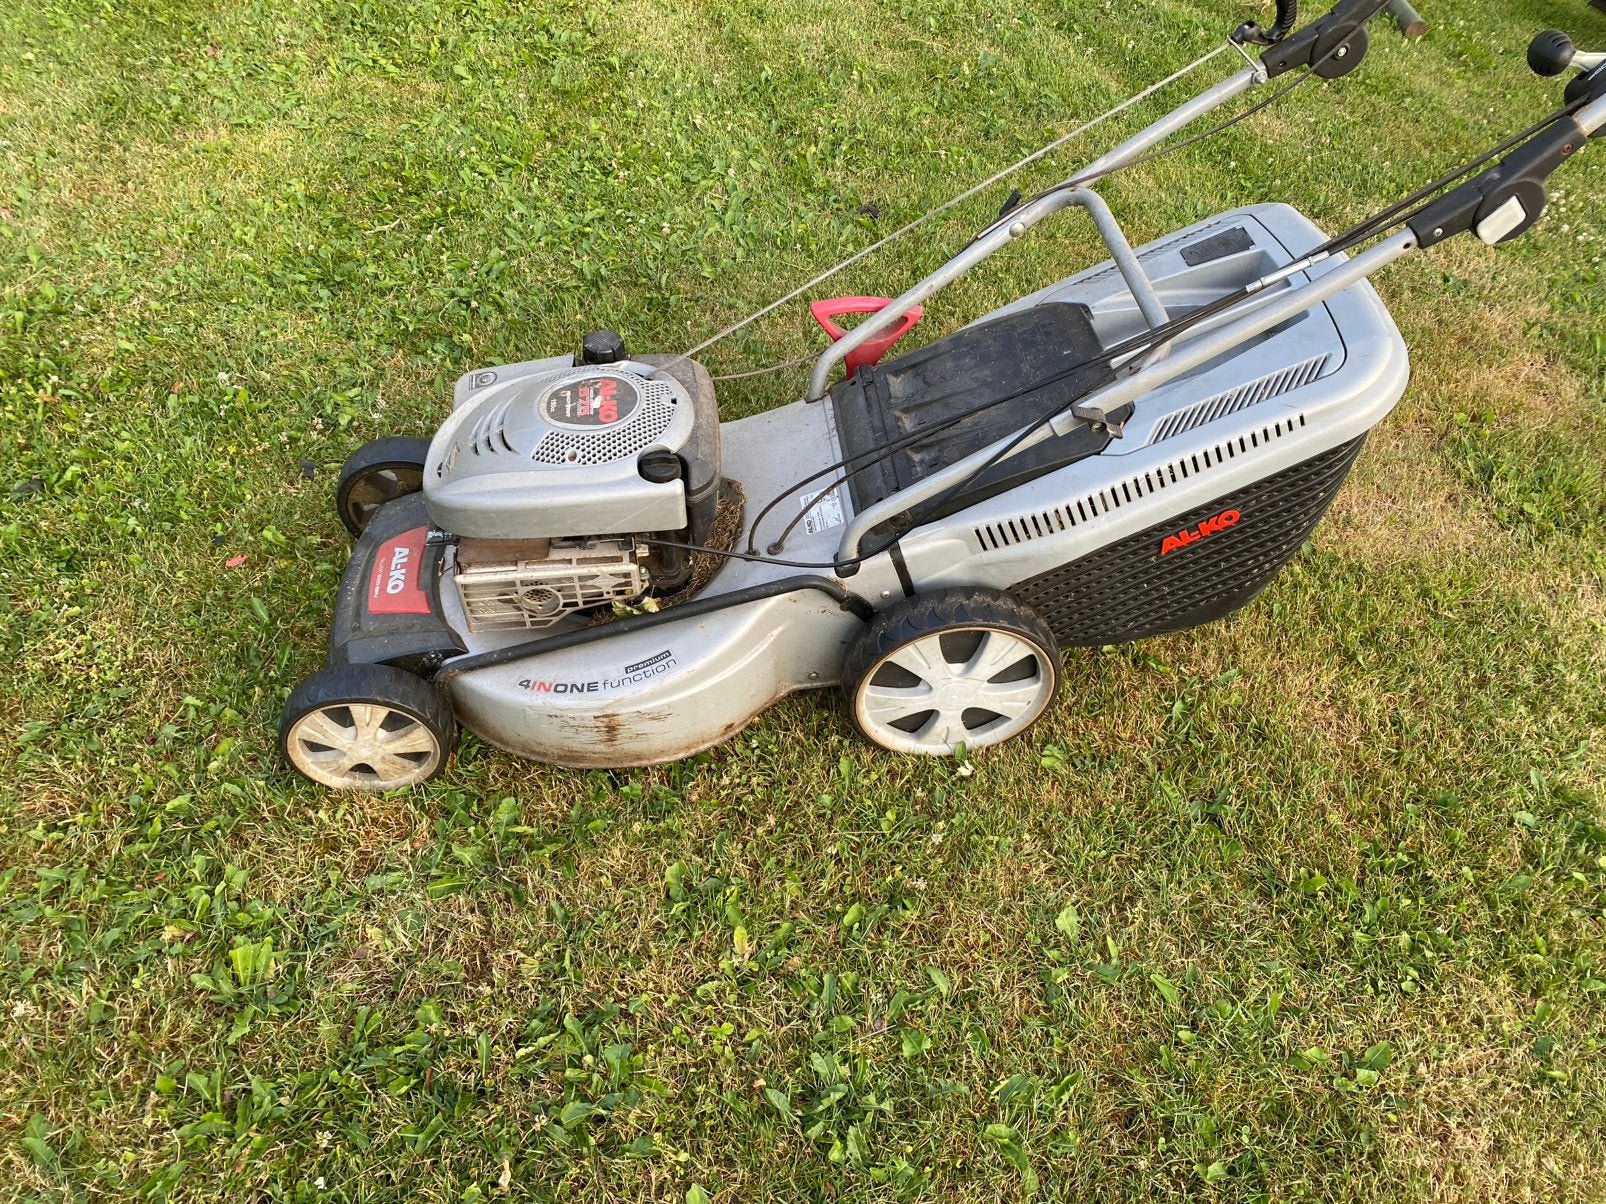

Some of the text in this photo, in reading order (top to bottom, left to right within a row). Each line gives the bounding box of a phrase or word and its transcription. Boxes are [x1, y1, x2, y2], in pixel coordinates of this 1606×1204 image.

[599, 378, 618, 423] AL-KO
[1160, 509, 1241, 556] AL-KO
[386, 547, 410, 594] AL-KO
[602, 658, 677, 691] function
[626, 650, 671, 673] premium
